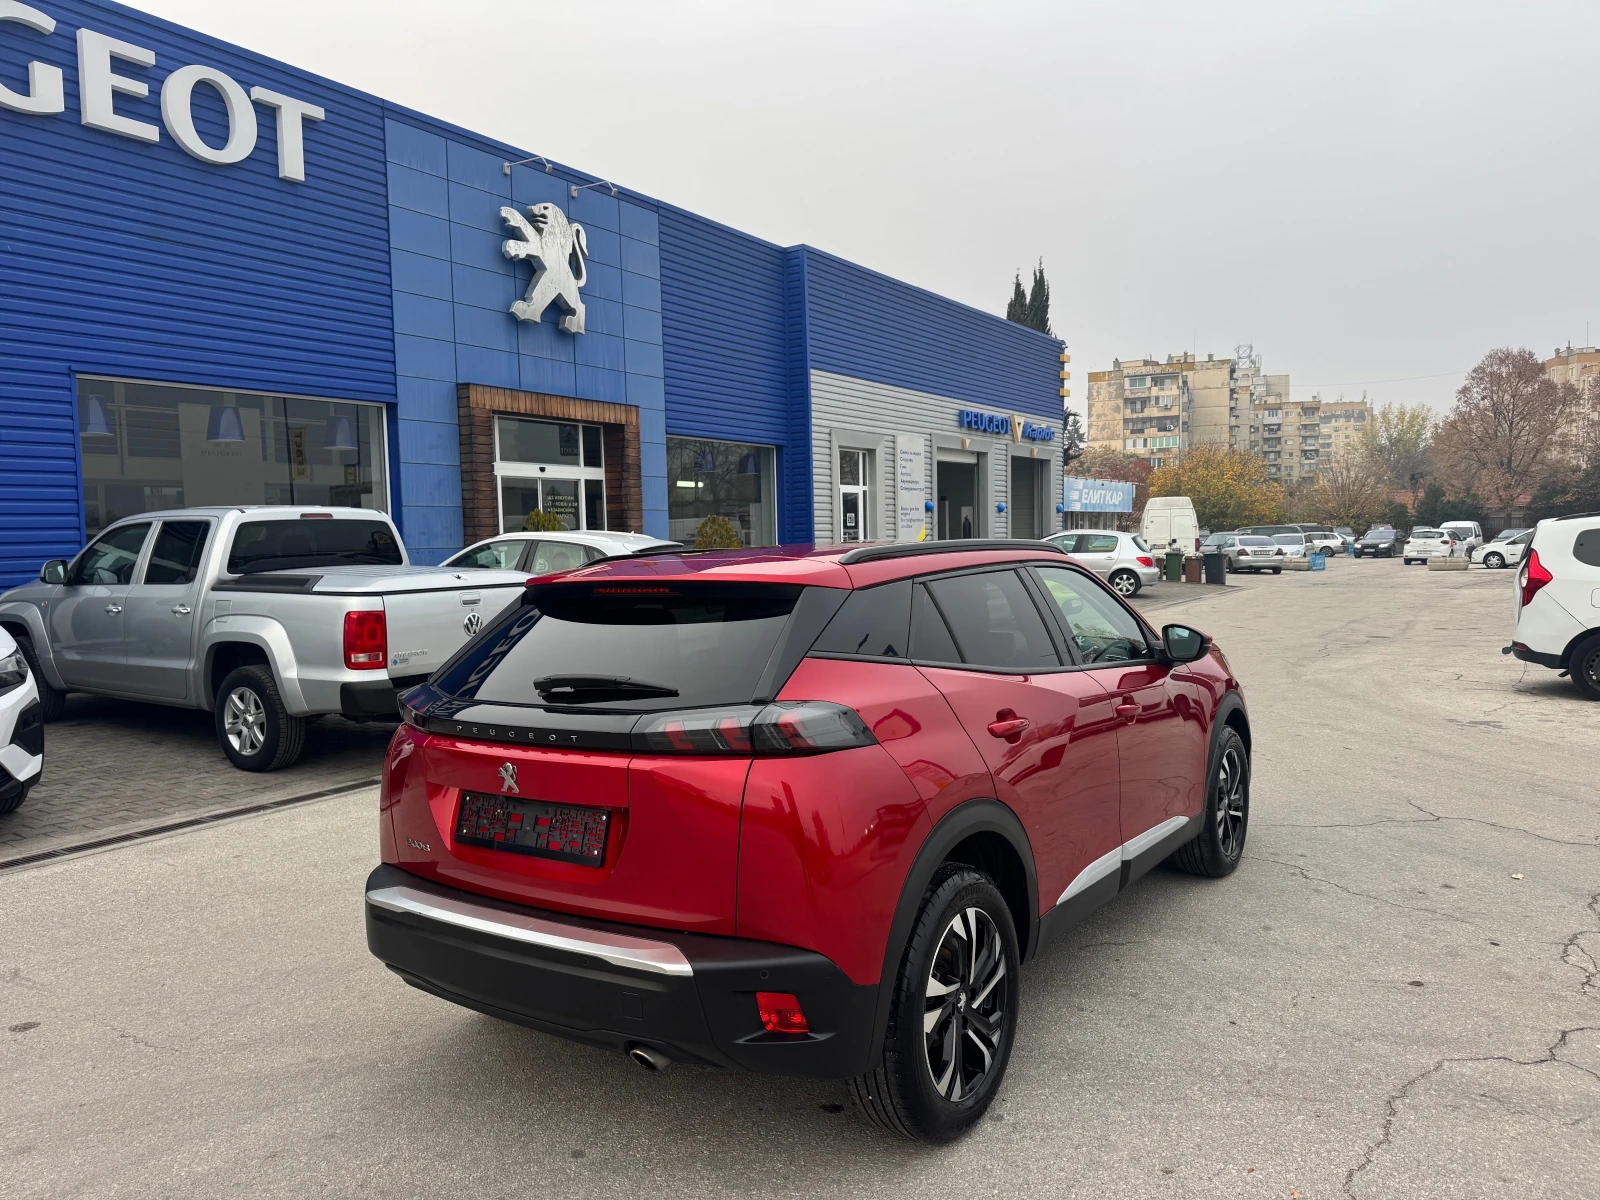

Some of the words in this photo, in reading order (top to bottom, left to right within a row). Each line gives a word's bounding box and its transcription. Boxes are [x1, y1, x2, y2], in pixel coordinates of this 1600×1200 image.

[959, 410, 1011, 434] PEUGEOT
[391, 648, 429, 659] AMAROK
[456, 725, 578, 743] PEUGEOT
[406, 837, 431, 852] 2008
